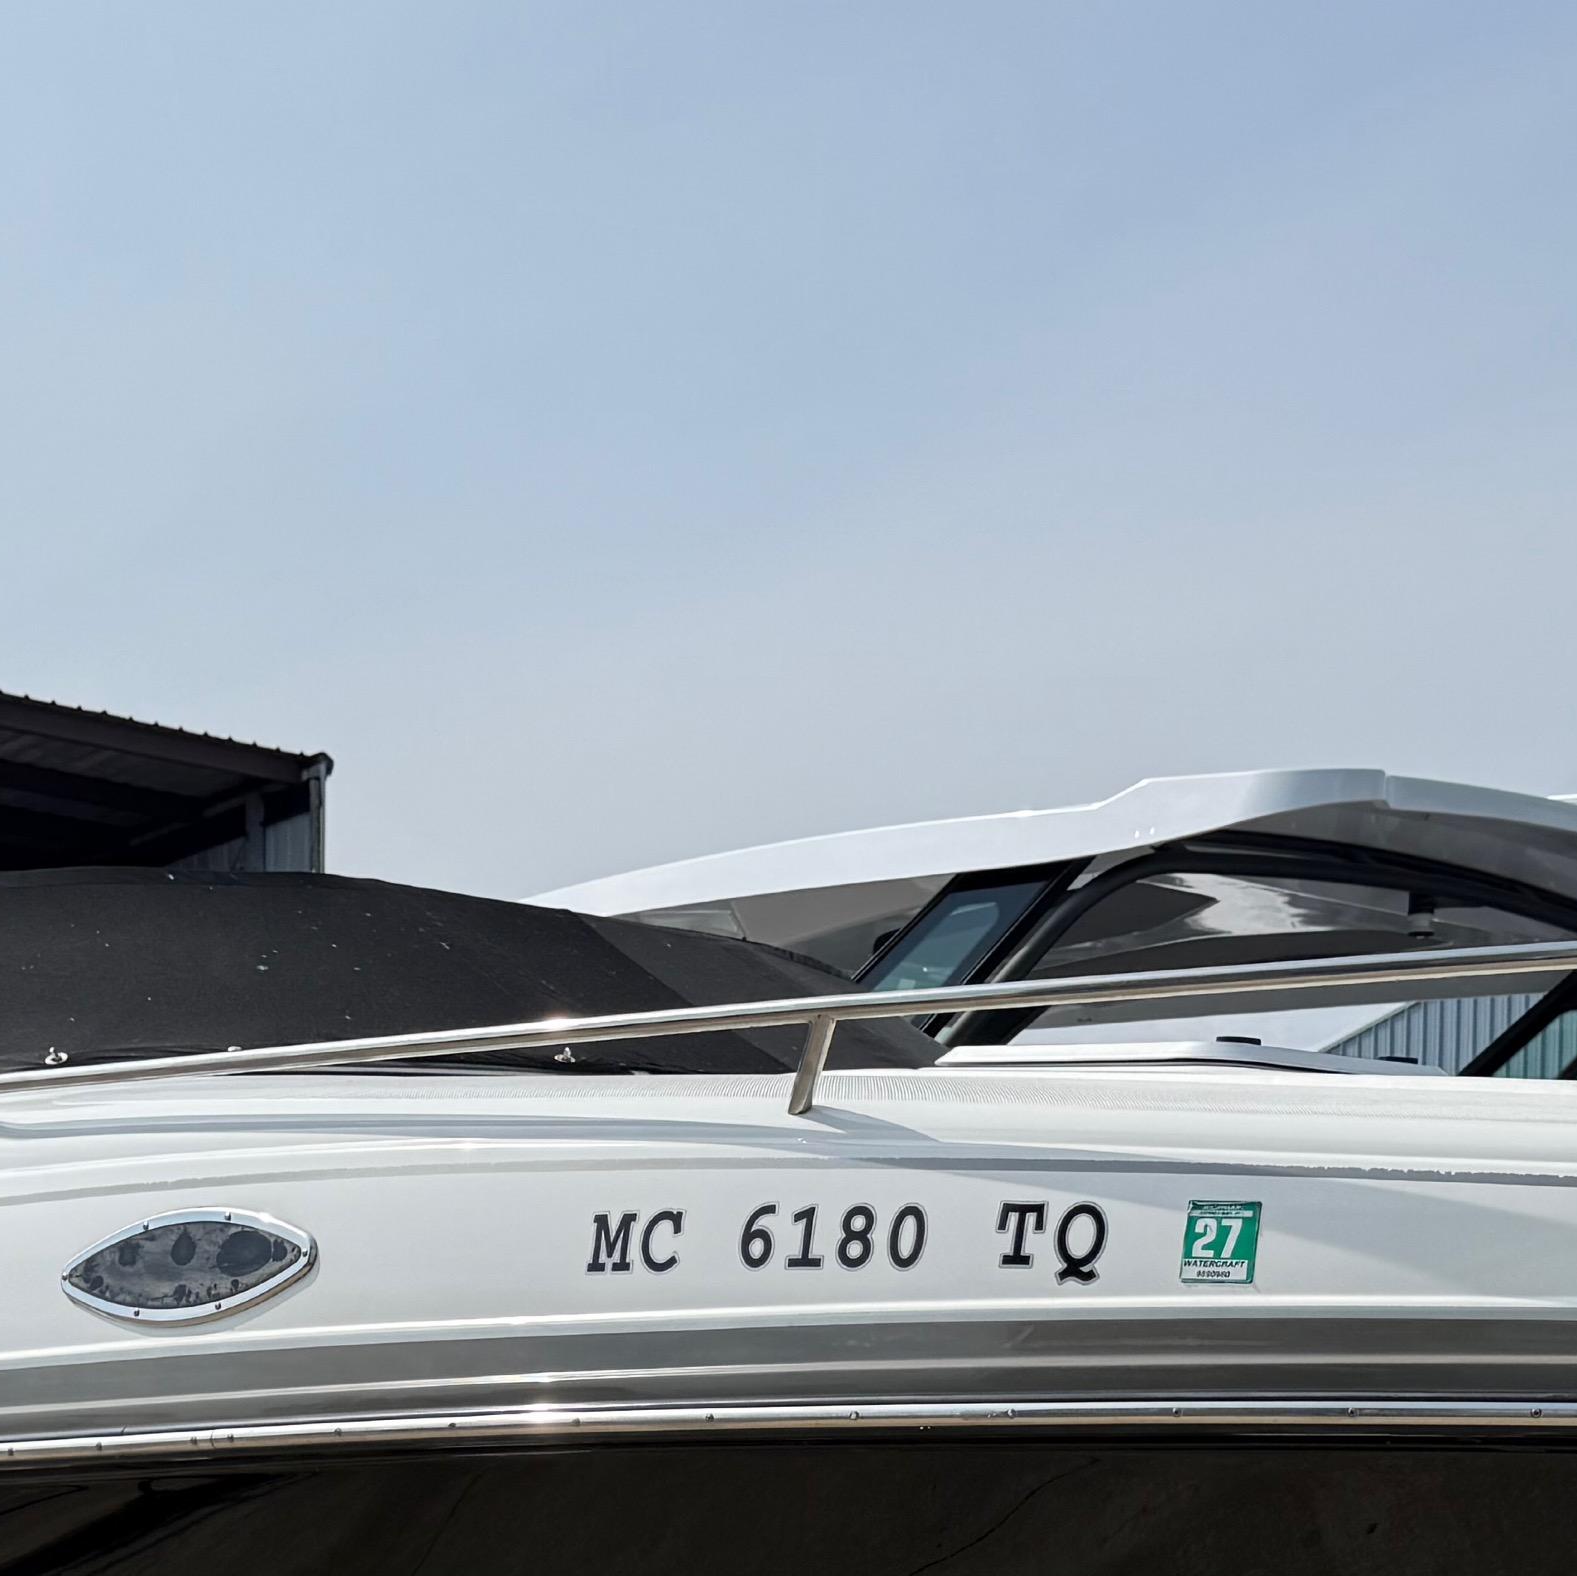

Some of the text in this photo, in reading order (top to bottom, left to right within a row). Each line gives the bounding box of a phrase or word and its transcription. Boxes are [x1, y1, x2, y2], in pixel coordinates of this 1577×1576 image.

[586, 1201, 1108, 1284] MC 6180 TQ
[1192, 1218, 1243, 1259] 27
[1184, 1260, 1246, 1268] WATERCRAFT
